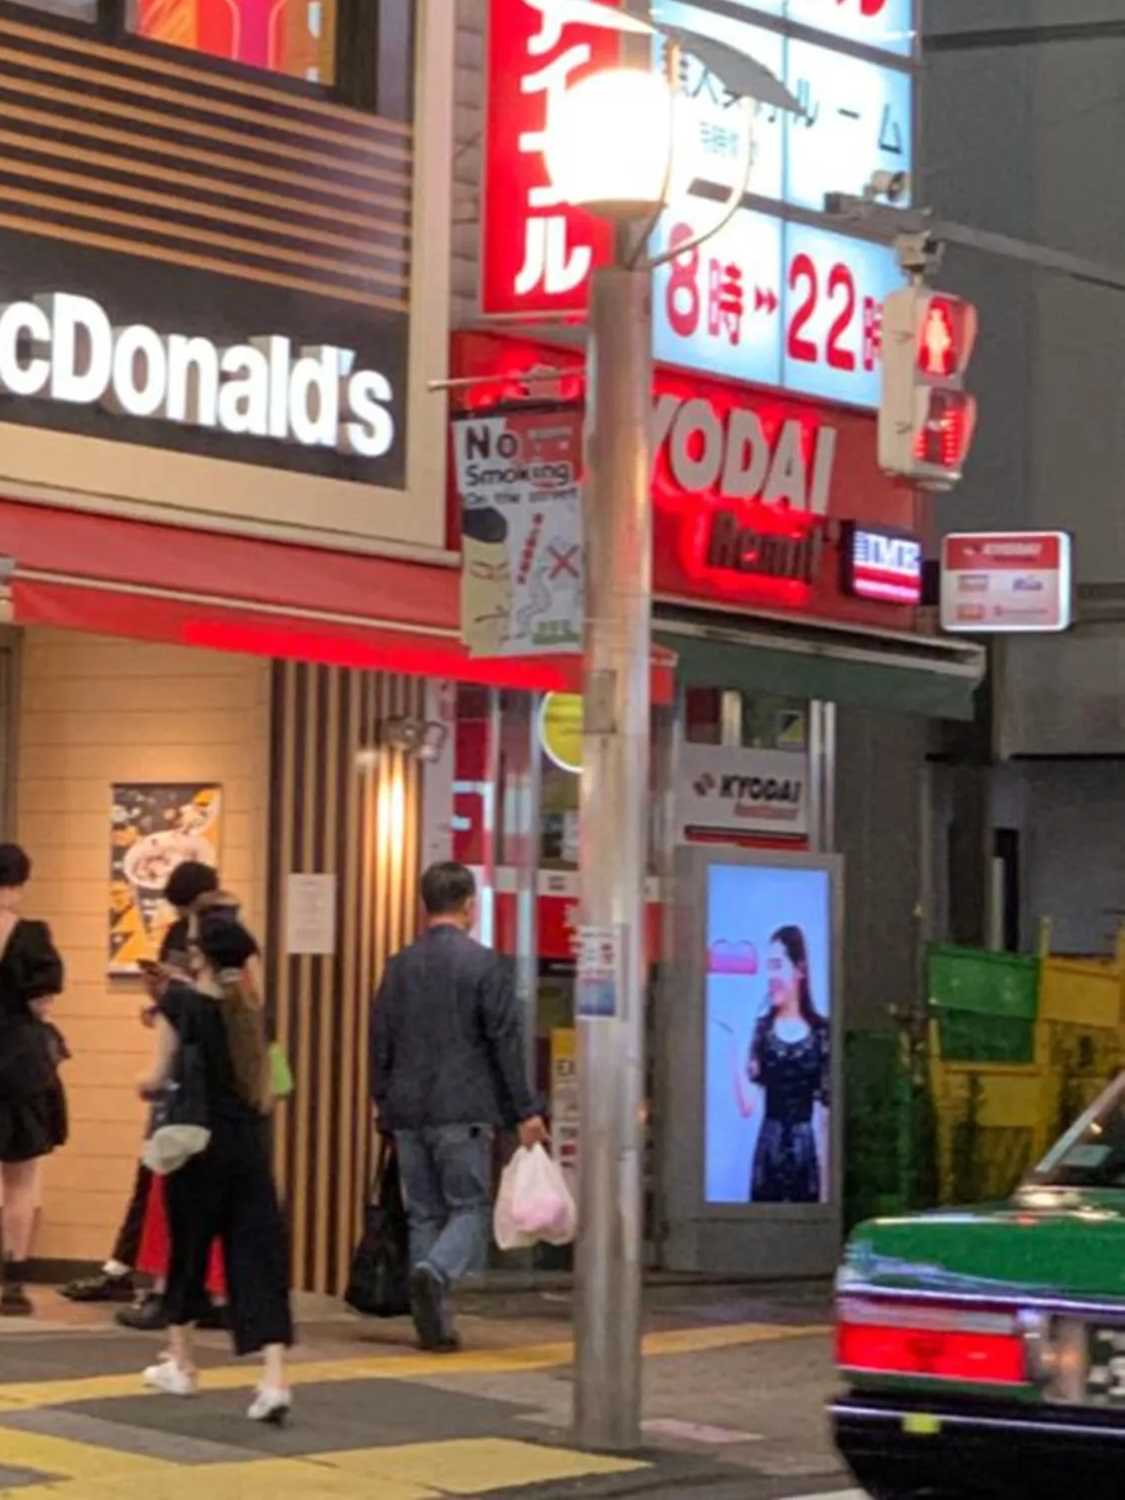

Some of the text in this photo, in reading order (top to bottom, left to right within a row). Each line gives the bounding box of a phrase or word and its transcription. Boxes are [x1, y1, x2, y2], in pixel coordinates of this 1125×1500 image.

[465, 425, 519, 460] No
[652, 392, 837, 516] YODAI
[465, 462, 571, 487] Smoking
[720, 773, 801, 803] KYODAI
